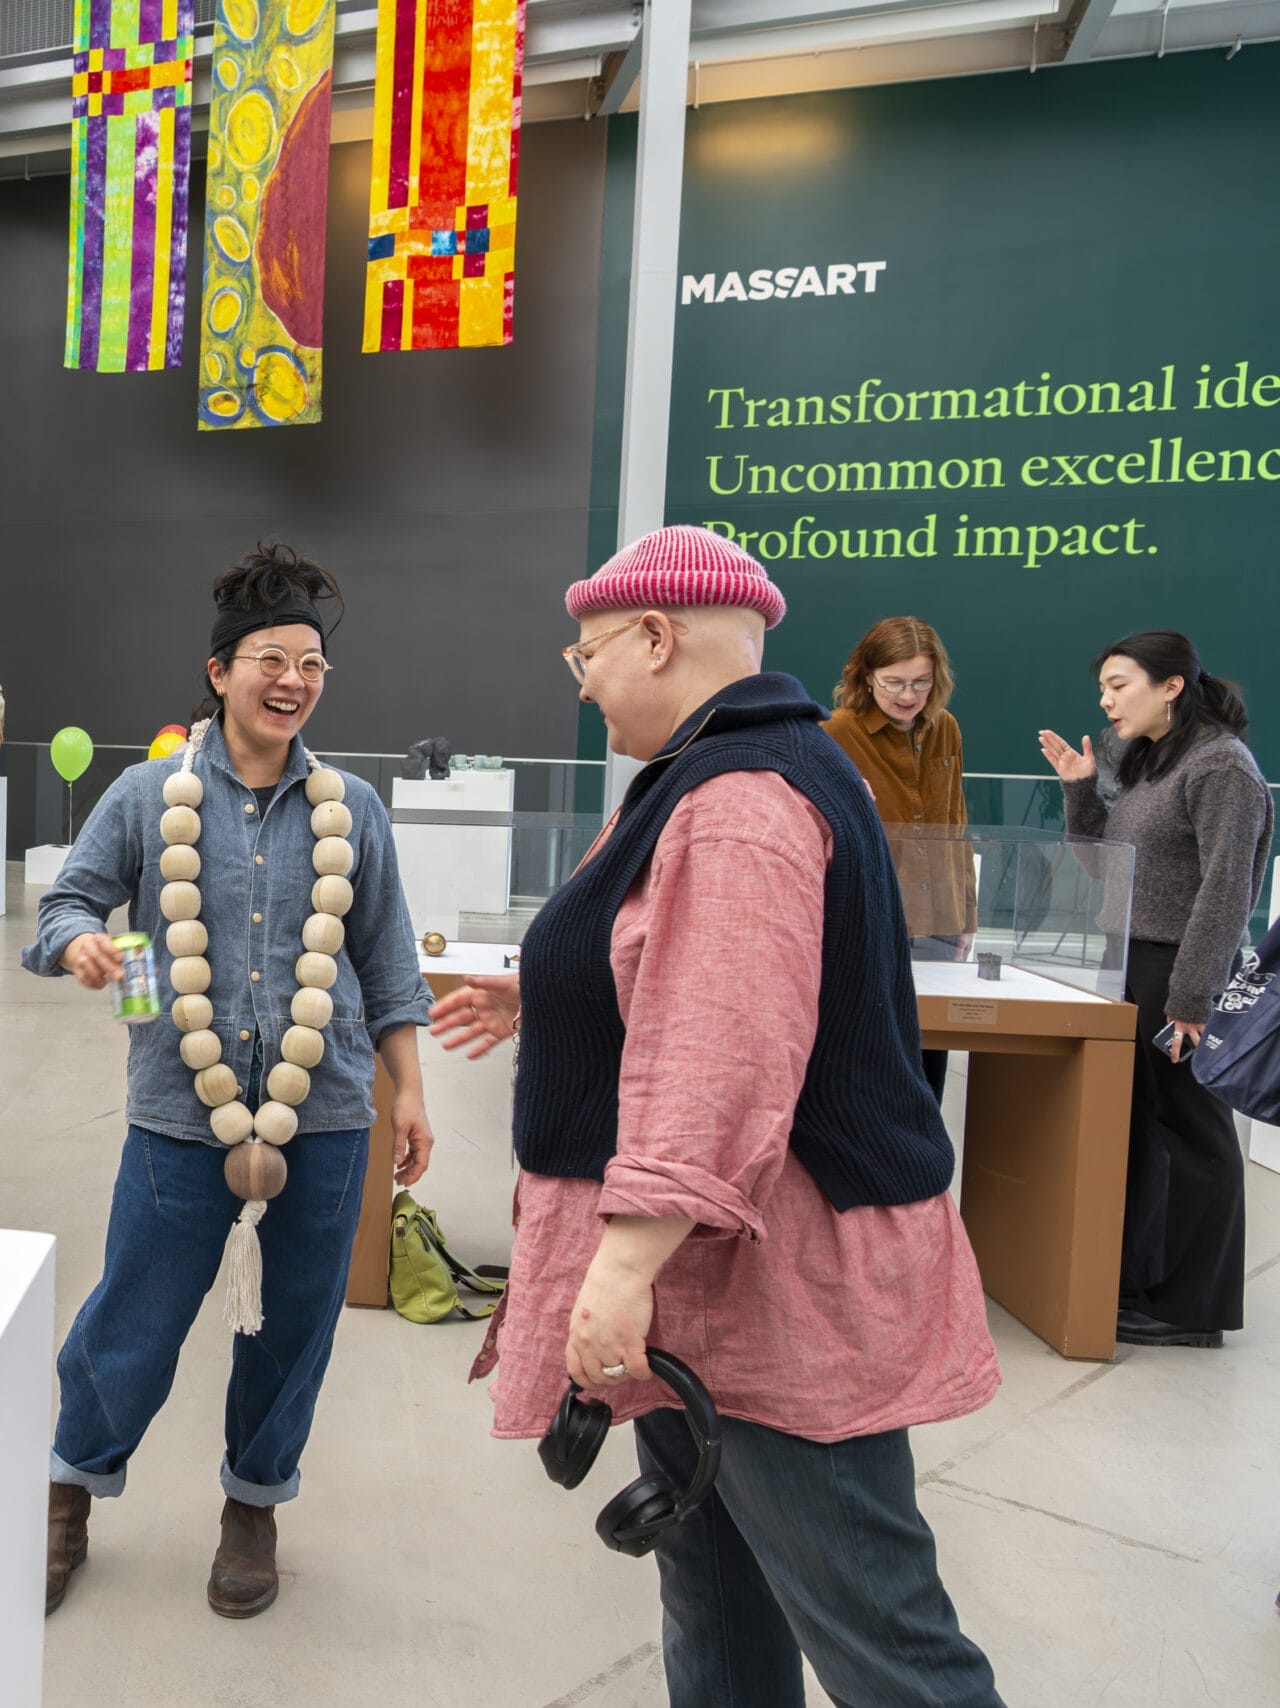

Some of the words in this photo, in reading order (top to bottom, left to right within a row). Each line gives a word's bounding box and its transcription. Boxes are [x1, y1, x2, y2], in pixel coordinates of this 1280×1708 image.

[681, 260, 887, 306] MASSART
[708, 365, 1177, 431] Transformational
[1193, 360, 1280, 410] ide
[706, 450, 1006, 497] Uncommon
[1021, 436, 1280, 487] excellenc
[952, 514, 1159, 569] impact.
